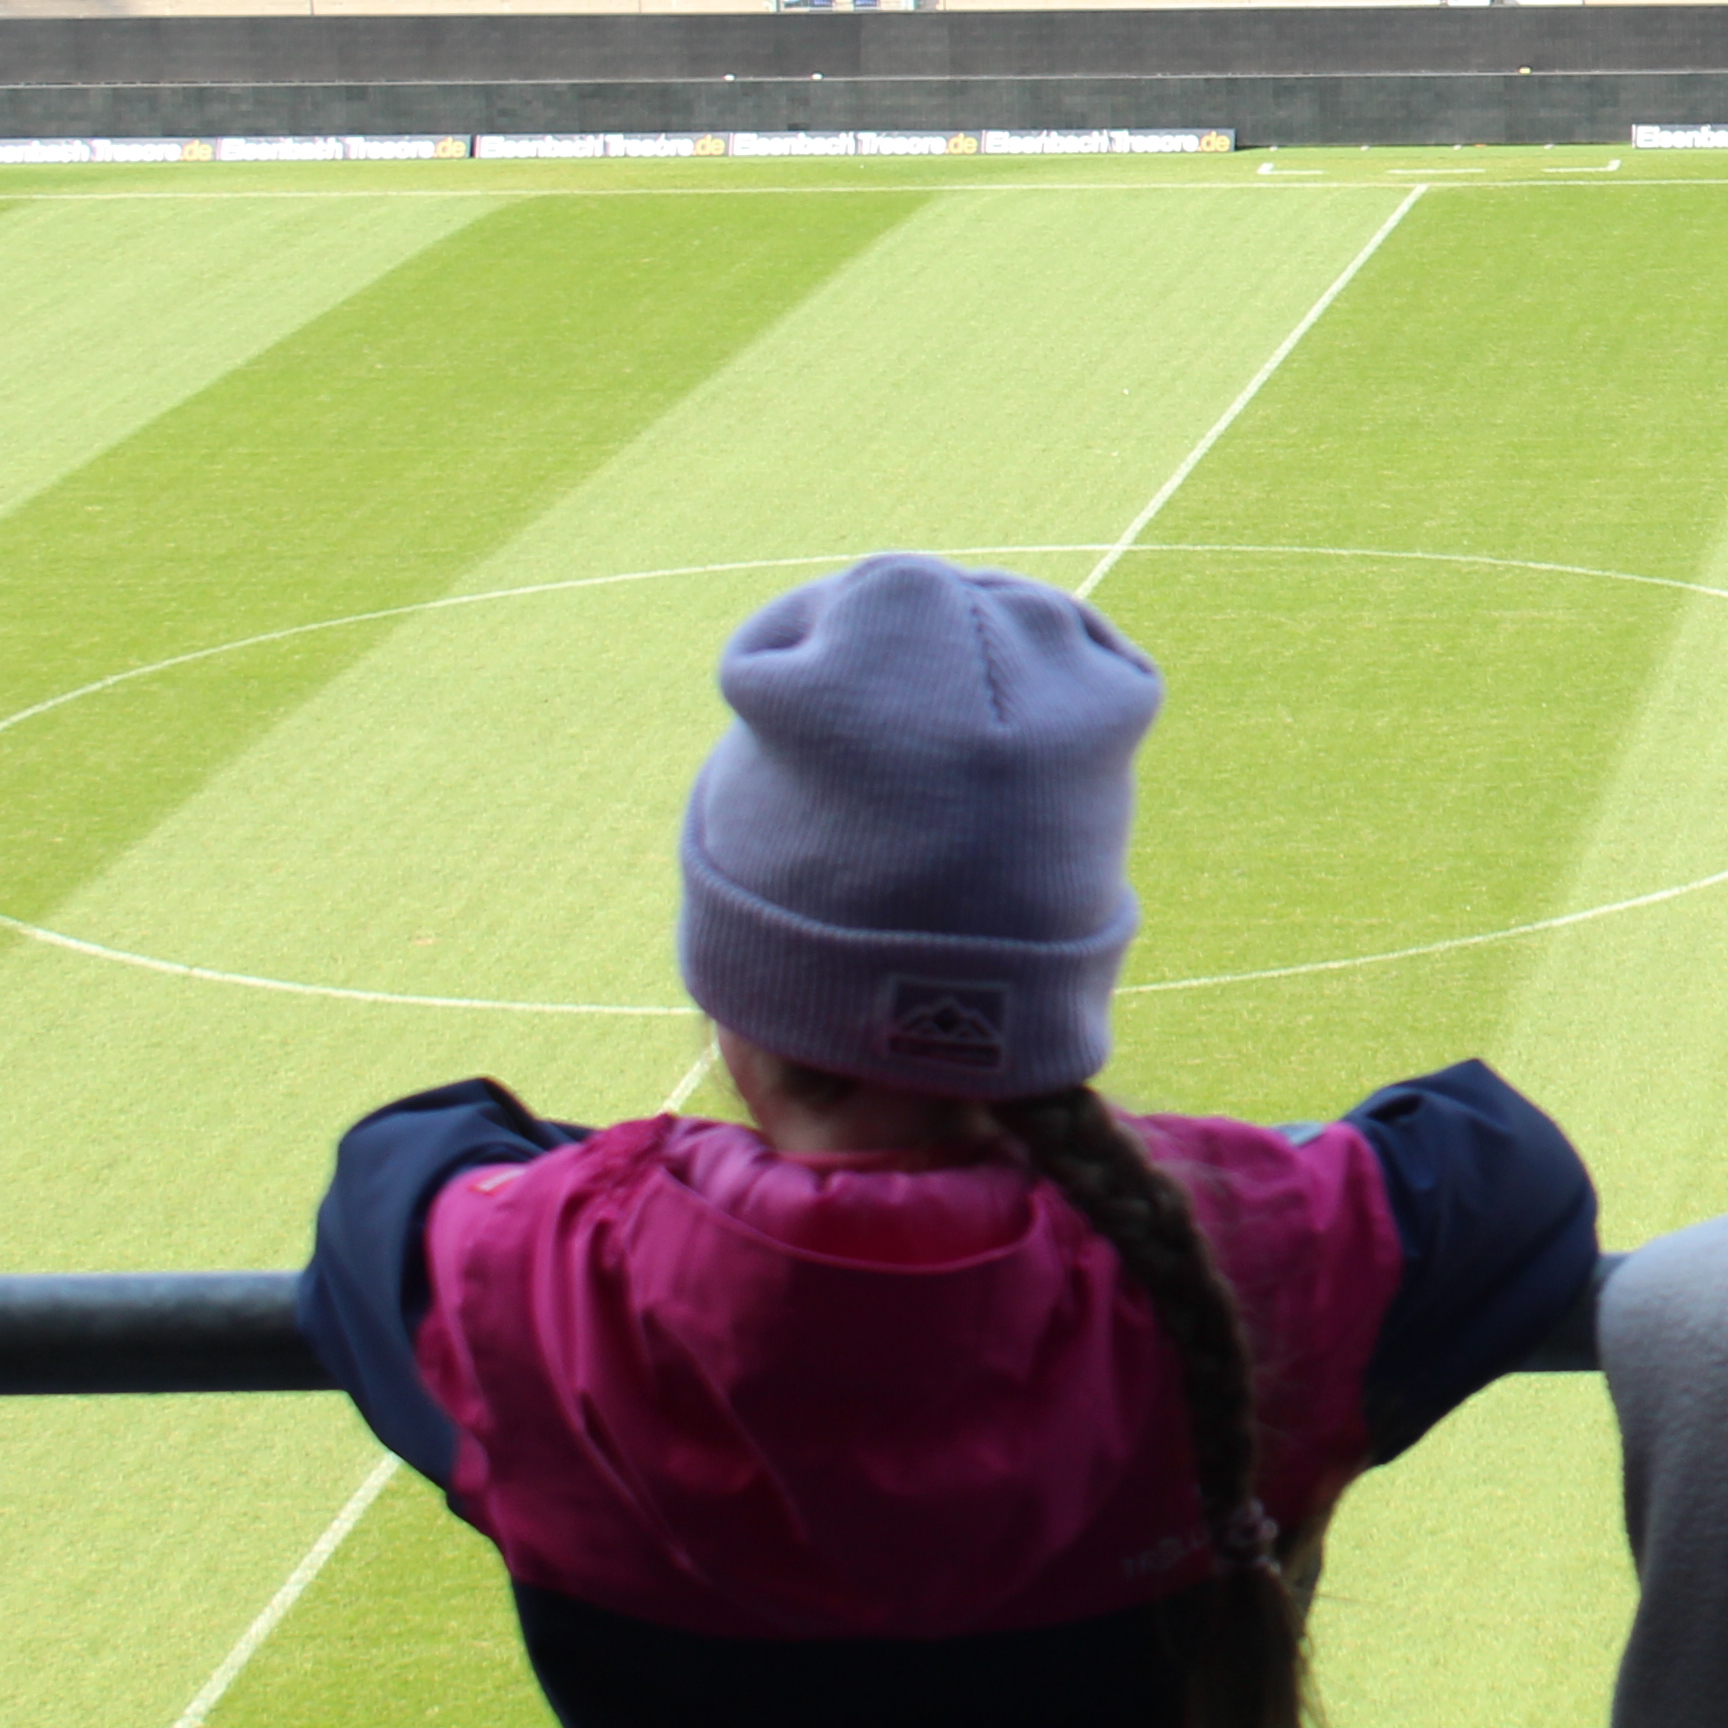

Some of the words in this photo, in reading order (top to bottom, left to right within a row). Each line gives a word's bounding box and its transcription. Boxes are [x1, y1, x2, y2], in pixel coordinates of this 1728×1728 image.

[346, 136, 466, 160] Tresore.de
[604, 133, 726, 158] Tresore.de
[858, 131, 978, 155] Tresore.de
[1110, 129, 1231, 153] Tresore.de
